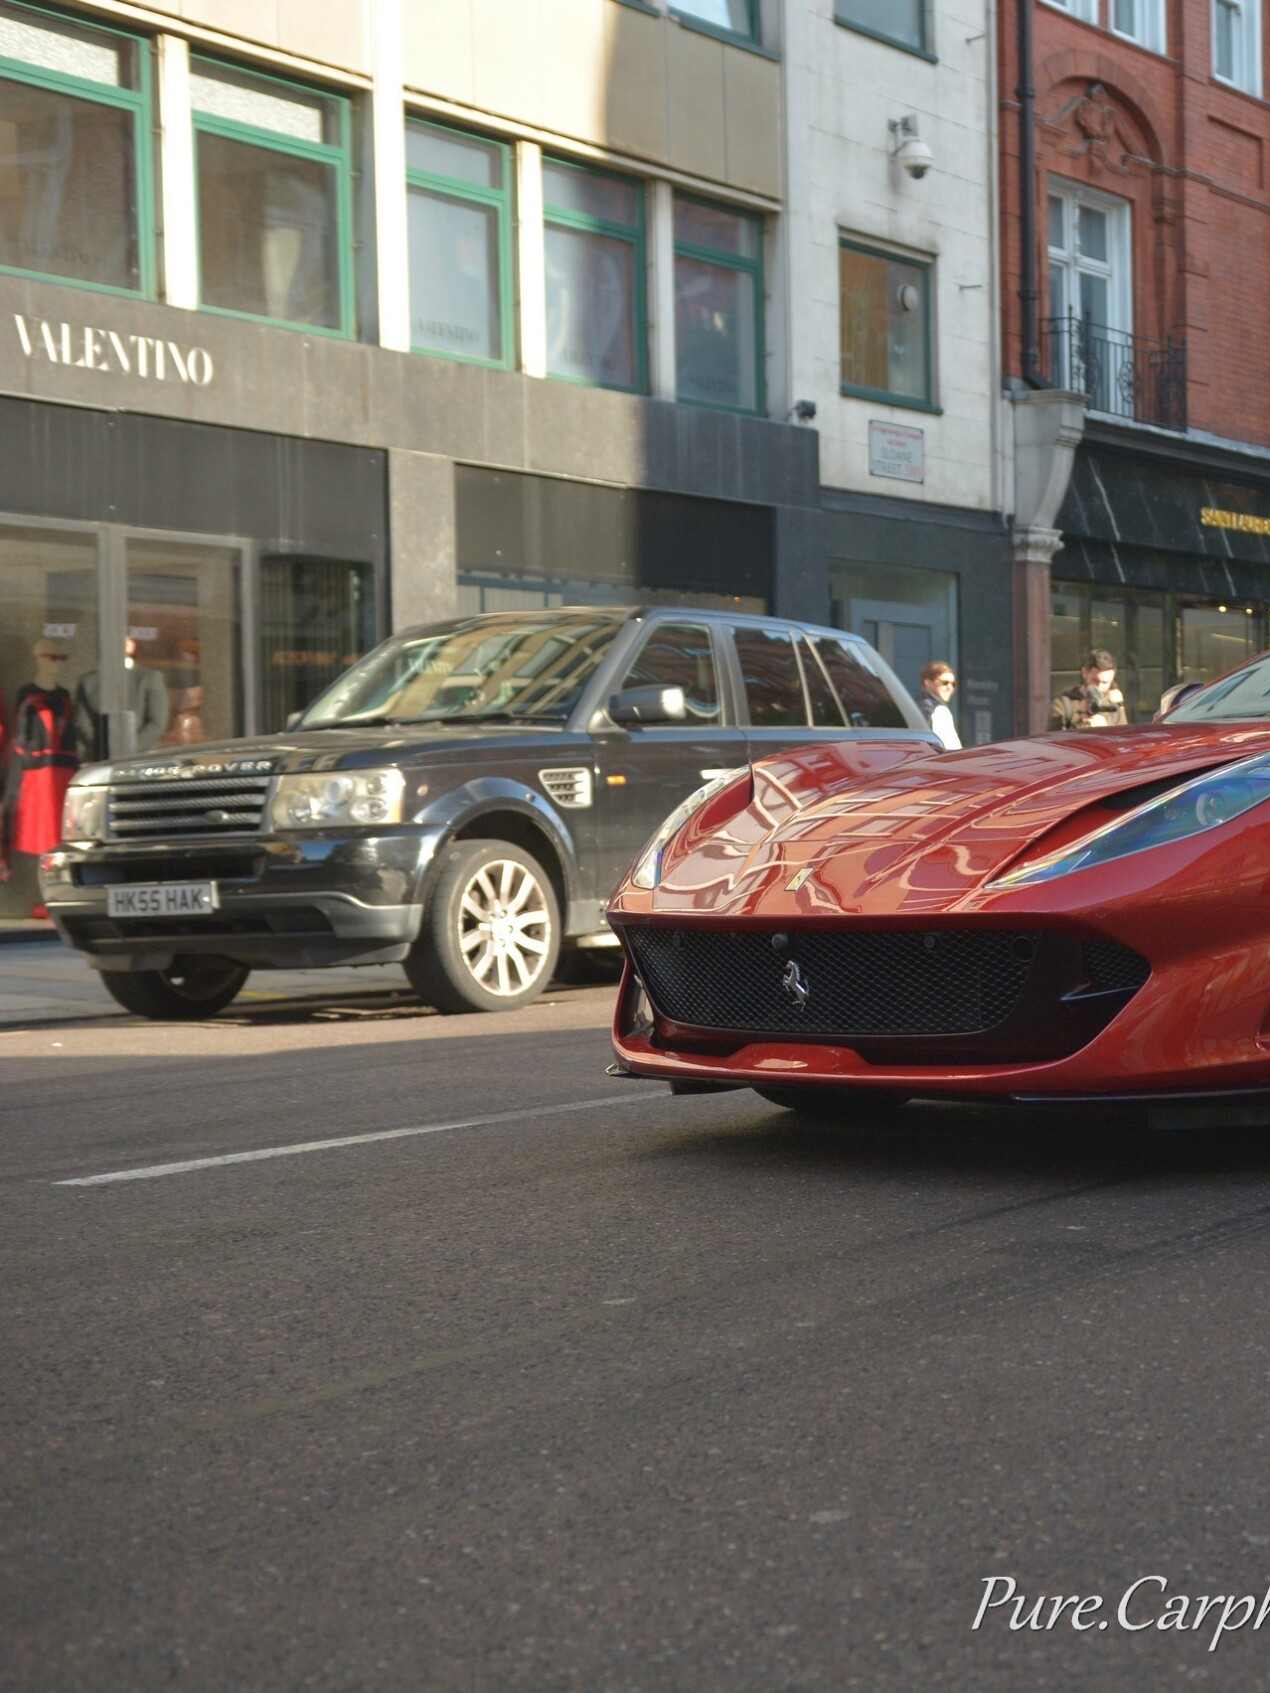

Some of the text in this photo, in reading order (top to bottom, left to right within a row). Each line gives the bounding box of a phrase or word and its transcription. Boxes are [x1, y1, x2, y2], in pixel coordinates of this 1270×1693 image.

[14, 313, 214, 387] VALENTINO
[191, 760, 273, 775] ROVER
[114, 888, 203, 913] HK55 HAK
